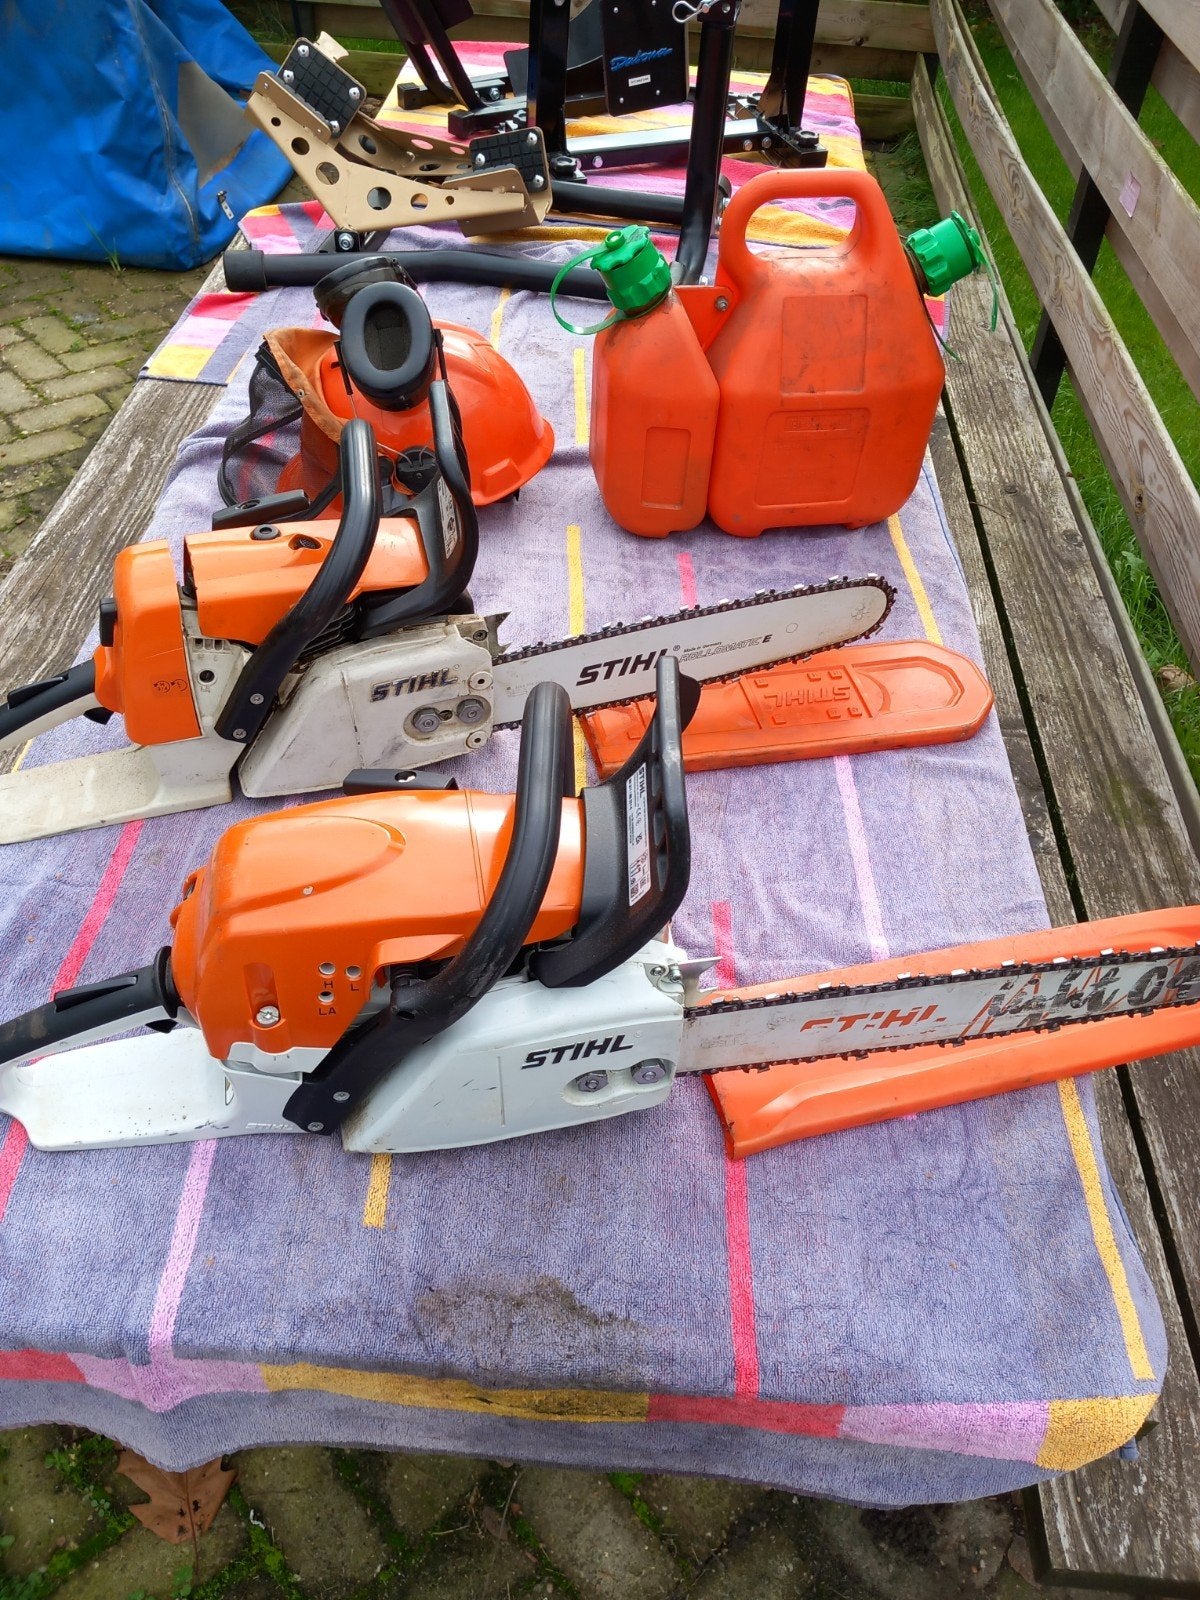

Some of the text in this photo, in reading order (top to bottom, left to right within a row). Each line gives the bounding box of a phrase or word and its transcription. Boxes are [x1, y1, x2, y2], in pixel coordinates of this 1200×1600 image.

[762, 634, 773, 644] E
[370, 667, 459, 702] STIHL
[764, 687, 850, 708] STIHL
[638, 767, 646, 798] STIHL
[324, 980, 360, 992] H L
[318, 1007, 337, 1016] LA
[521, 1034, 634, 1069] STIHL
